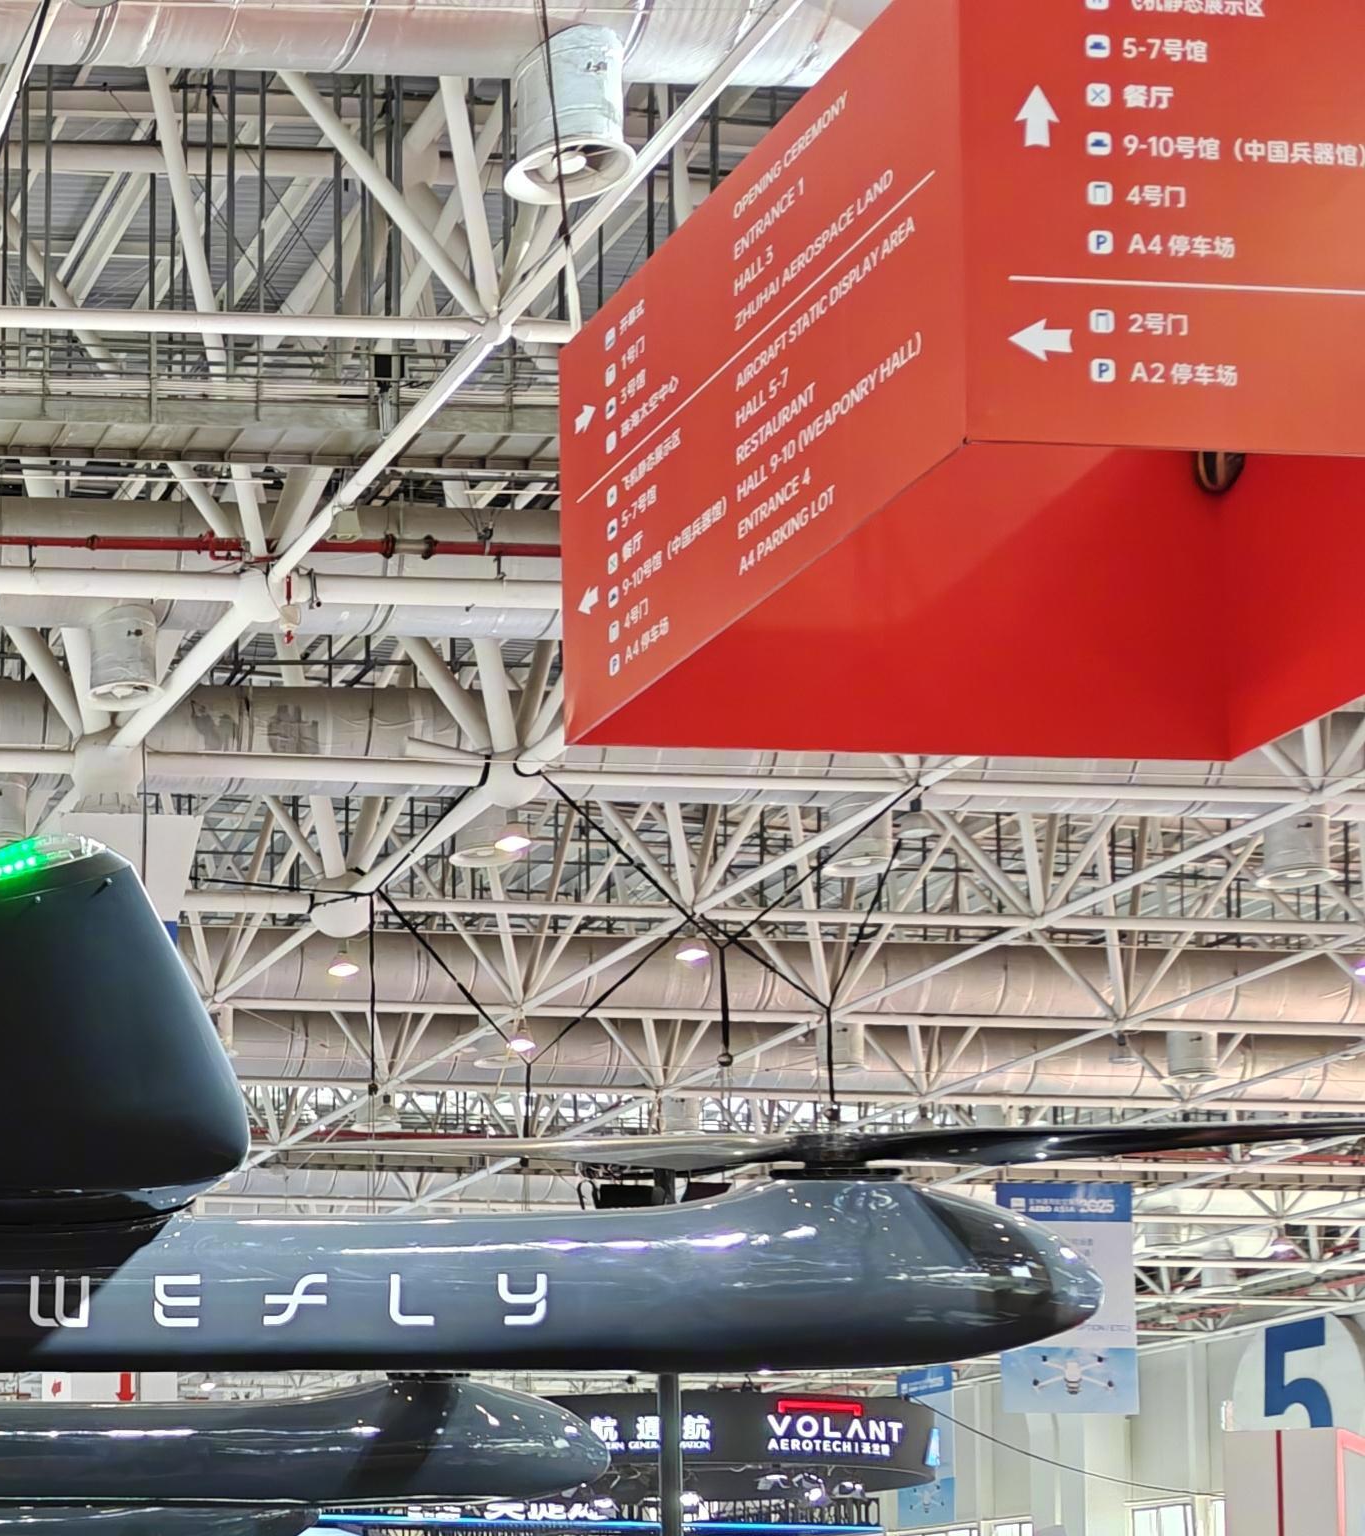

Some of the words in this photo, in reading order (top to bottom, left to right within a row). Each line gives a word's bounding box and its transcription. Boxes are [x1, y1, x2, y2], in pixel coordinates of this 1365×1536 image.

[1122, 38, 1208, 62] 5-7号馆
[1123, 85, 1173, 109] 餐厅
[733, 160, 782, 219] OPENING
[784, 89, 848, 168] CEREMONY
[1126, 185, 1186, 207] 4号门
[733, 186, 795, 260] ENTRANCE
[798, 177, 805, 195] 1
[734, 276, 780, 332] ZHUHAI
[782, 204, 855, 287] AEROSPACE
[856, 169, 894, 216] LAND
[1128, 234, 1162, 254] A4
[1168, 236, 1235, 258] 停车场
[733, 256, 765, 296] HALL
[765, 245, 774, 265] 3
[736, 330, 788, 392] AIRCRAFT
[788, 295, 828, 343] STATIC
[829, 246, 880, 307] DISPLAY
[881, 216, 916, 260] AREA
[1128, 313, 1189, 335] 2号门
[621, 335, 645, 370] 1号门
[1130, 363, 1165, 382] A2
[1171, 364, 1237, 386] 停车场
[735, 390, 767, 428] HALL
[768, 367, 789, 399] 5-7
[737, 464, 769, 502] HALL
[770, 439, 796, 473] 9-10
[798, 368, 878, 452] (WEAPONRY
[879, 331, 922, 383] HALL)
[736, 382, 816, 465] RESTAURANT
[738, 475, 799, 540] ENTRANCE
[802, 467, 811, 485] 4
[739, 549, 755, 576] A4
[757, 507, 809, 562] PARKING
[811, 484, 835, 519] LOT
[624, 598, 649, 629] 4号门
[625, 640, 639, 664] A4
[1264, 1316, 1333, 1428] 5
[767, 1415, 903, 1443] VOLANT
[767, 1438, 853, 1452] AEROTECH
